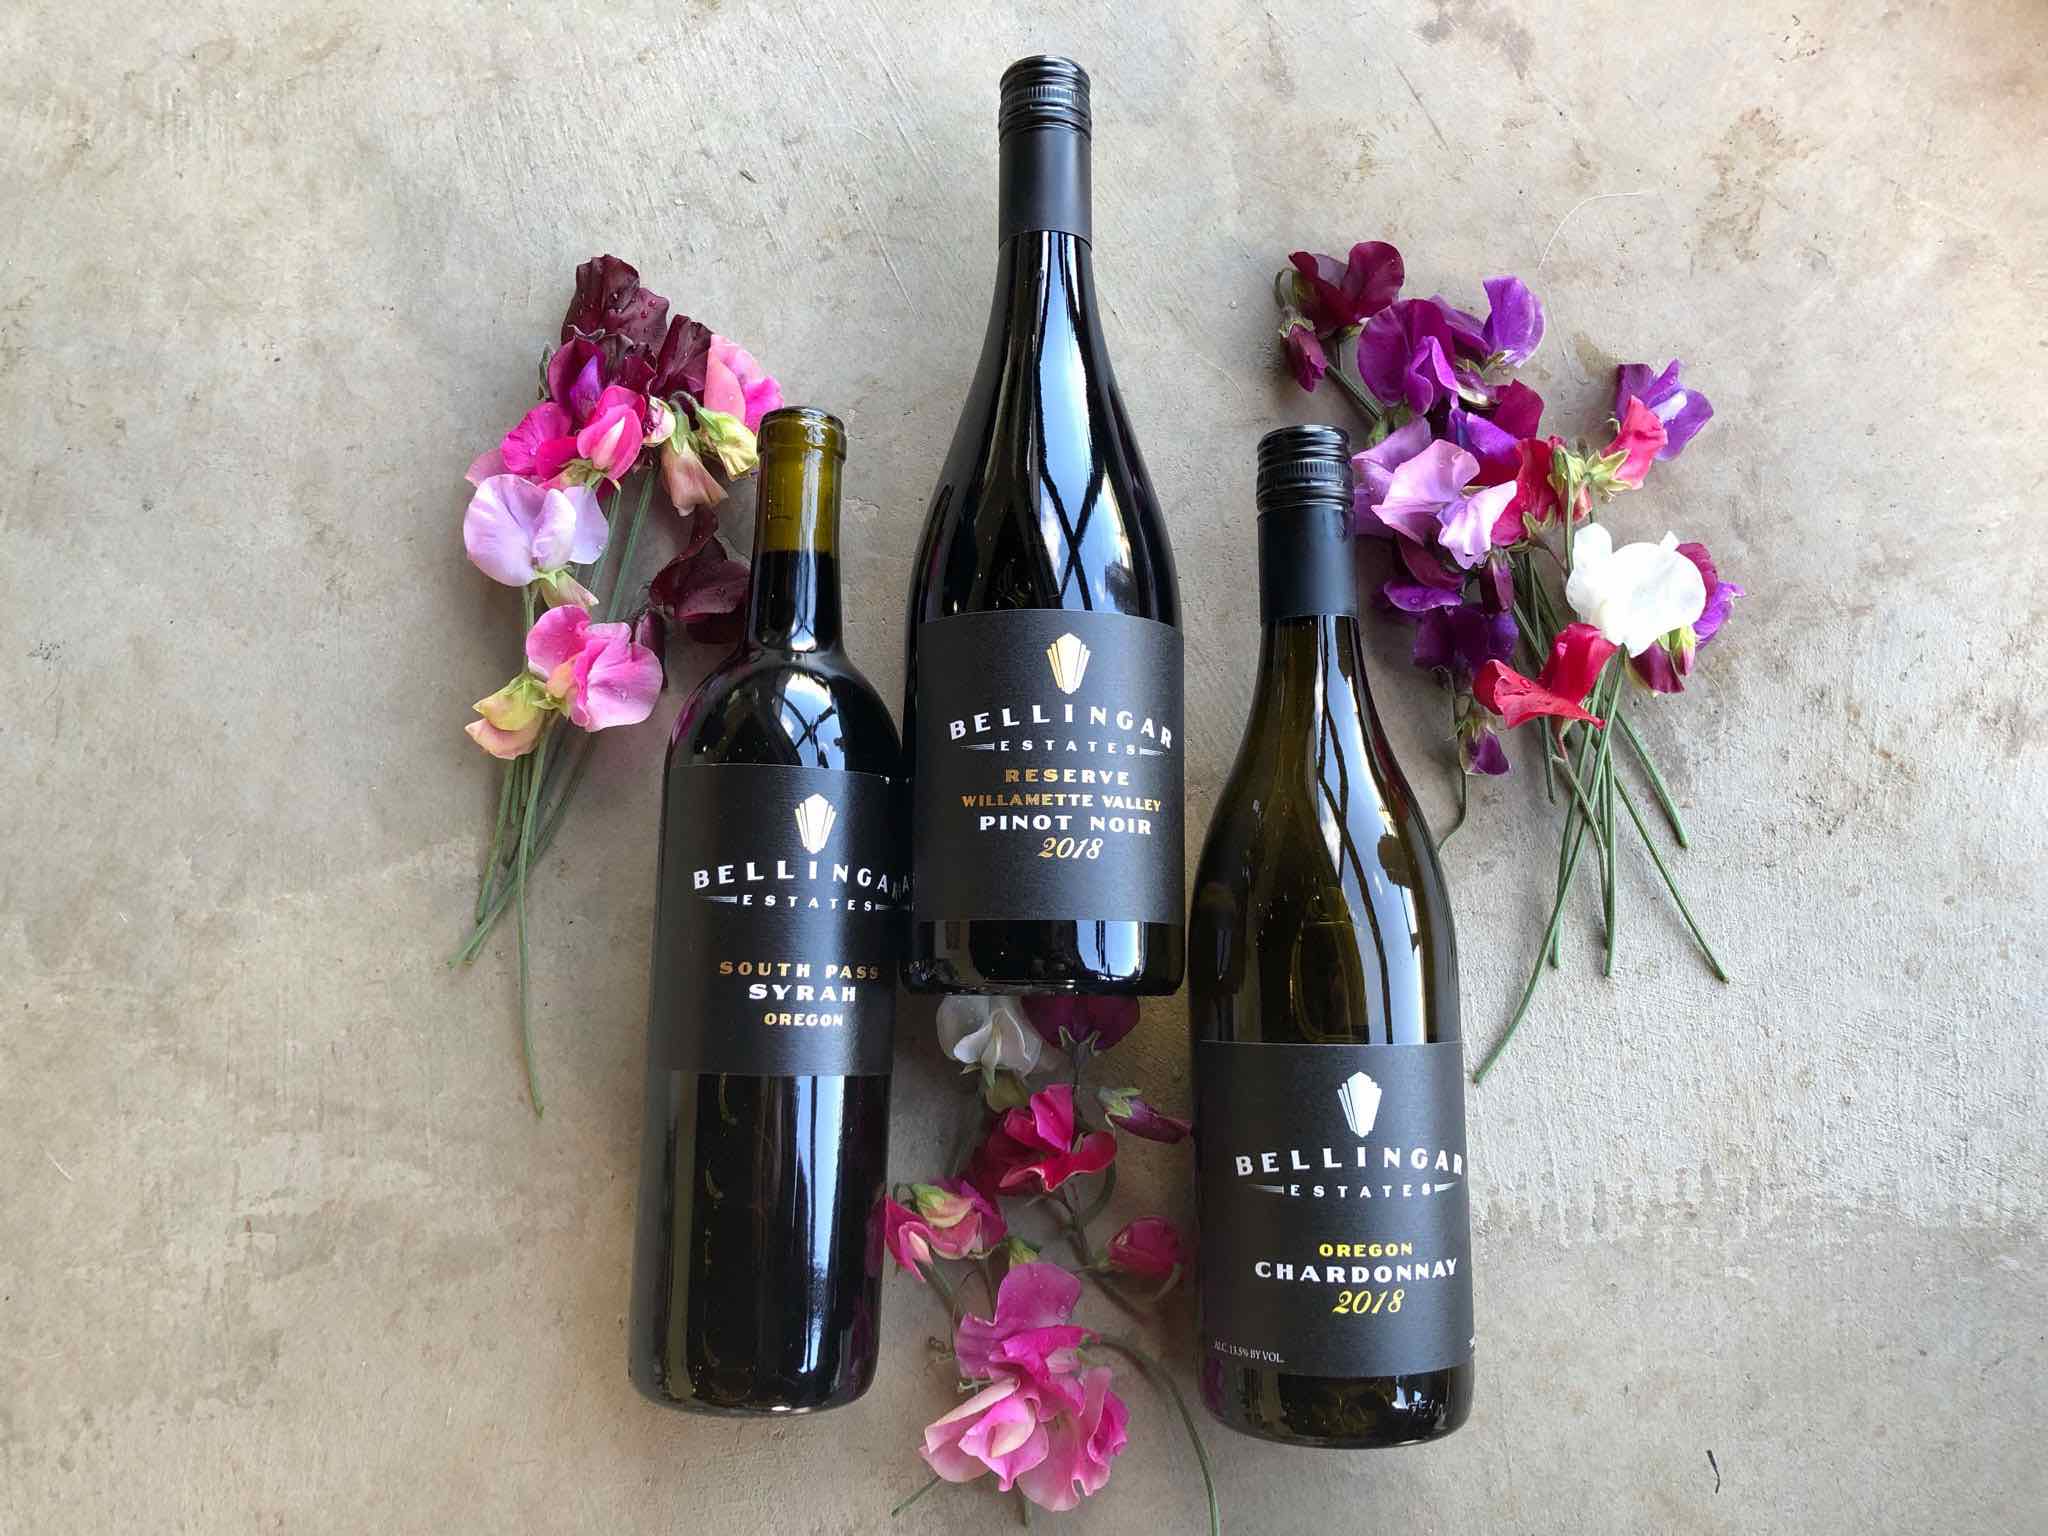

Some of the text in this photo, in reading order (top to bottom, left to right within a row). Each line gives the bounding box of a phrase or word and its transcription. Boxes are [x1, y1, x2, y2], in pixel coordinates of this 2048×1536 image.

[950, 704, 1172, 749] BELLINGAR
[1000, 740, 1135, 755] ESTATES
[1005, 768, 1129, 785] RESERVE
[960, 794, 1161, 813] WILLAMETTE VALLEY
[980, 815, 1152, 834] PINOT NOIR
[1037, 837, 1104, 860] 2018
[742, 895, 872, 911] ESTATES
[720, 961, 880, 979] SOUTH PASS
[749, 984, 856, 1002] SYRAH
[764, 1013, 843, 1026] OREGON
[1235, 1146, 1463, 1176] BELLINGAR
[1291, 1183, 1431, 1198] ESTATES
[1319, 1242, 1412, 1257] OREGON
[1255, 1257, 1457, 1283] CHARDONNAY
[1332, 1289, 1405, 1314] 2018
[1250, 1348, 1261, 1360] BY
